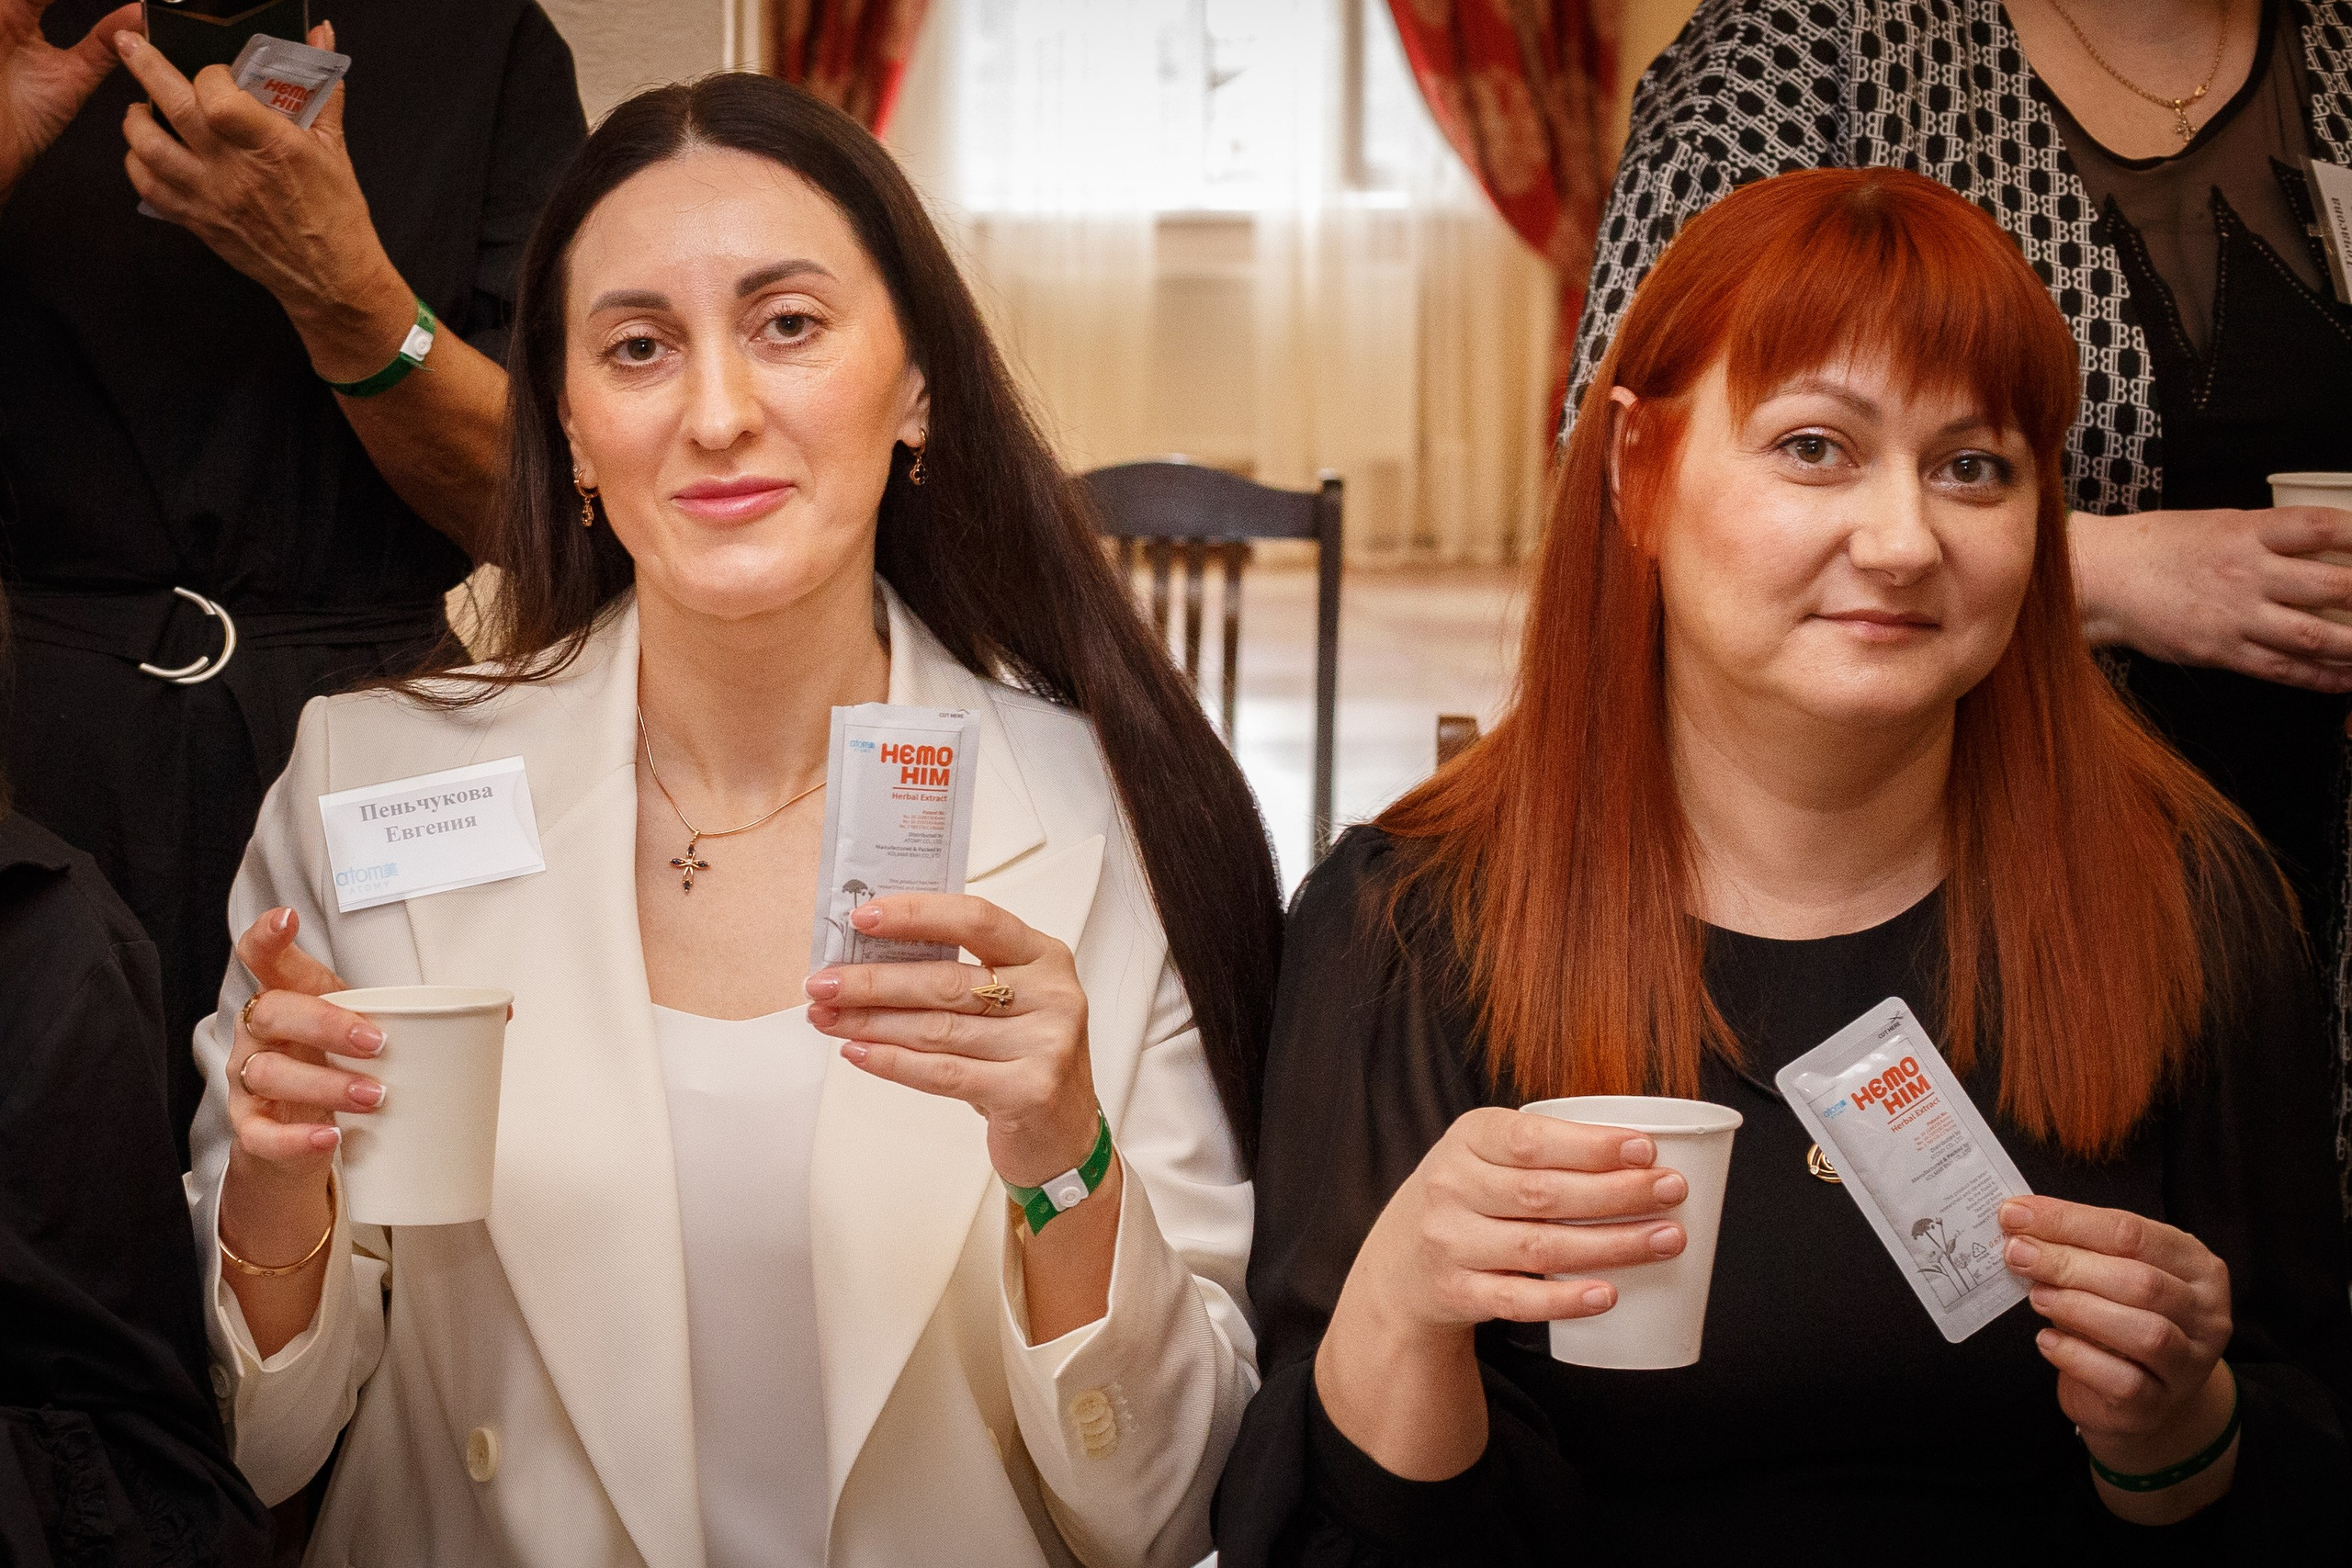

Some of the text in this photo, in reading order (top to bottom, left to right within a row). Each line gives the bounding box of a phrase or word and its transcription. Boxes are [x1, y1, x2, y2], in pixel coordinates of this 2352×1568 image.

[880, 743, 953, 767] HEMO
[900, 766, 949, 786] HIM
[359, 785, 493, 821] Пеньчукова
[891, 792, 946, 802] Herbal Extract
[386, 815, 477, 843] Евгения
[349, 881, 390, 895] ATOMY
[1878, 1021, 1901, 1039] CUT HERE
[1851, 1056, 1919, 1111] HEMO
[1881, 1074, 1931, 1115] HIM
[1891, 1113, 1916, 1133] Herbal
[1915, 1098, 1940, 1117] Extract
